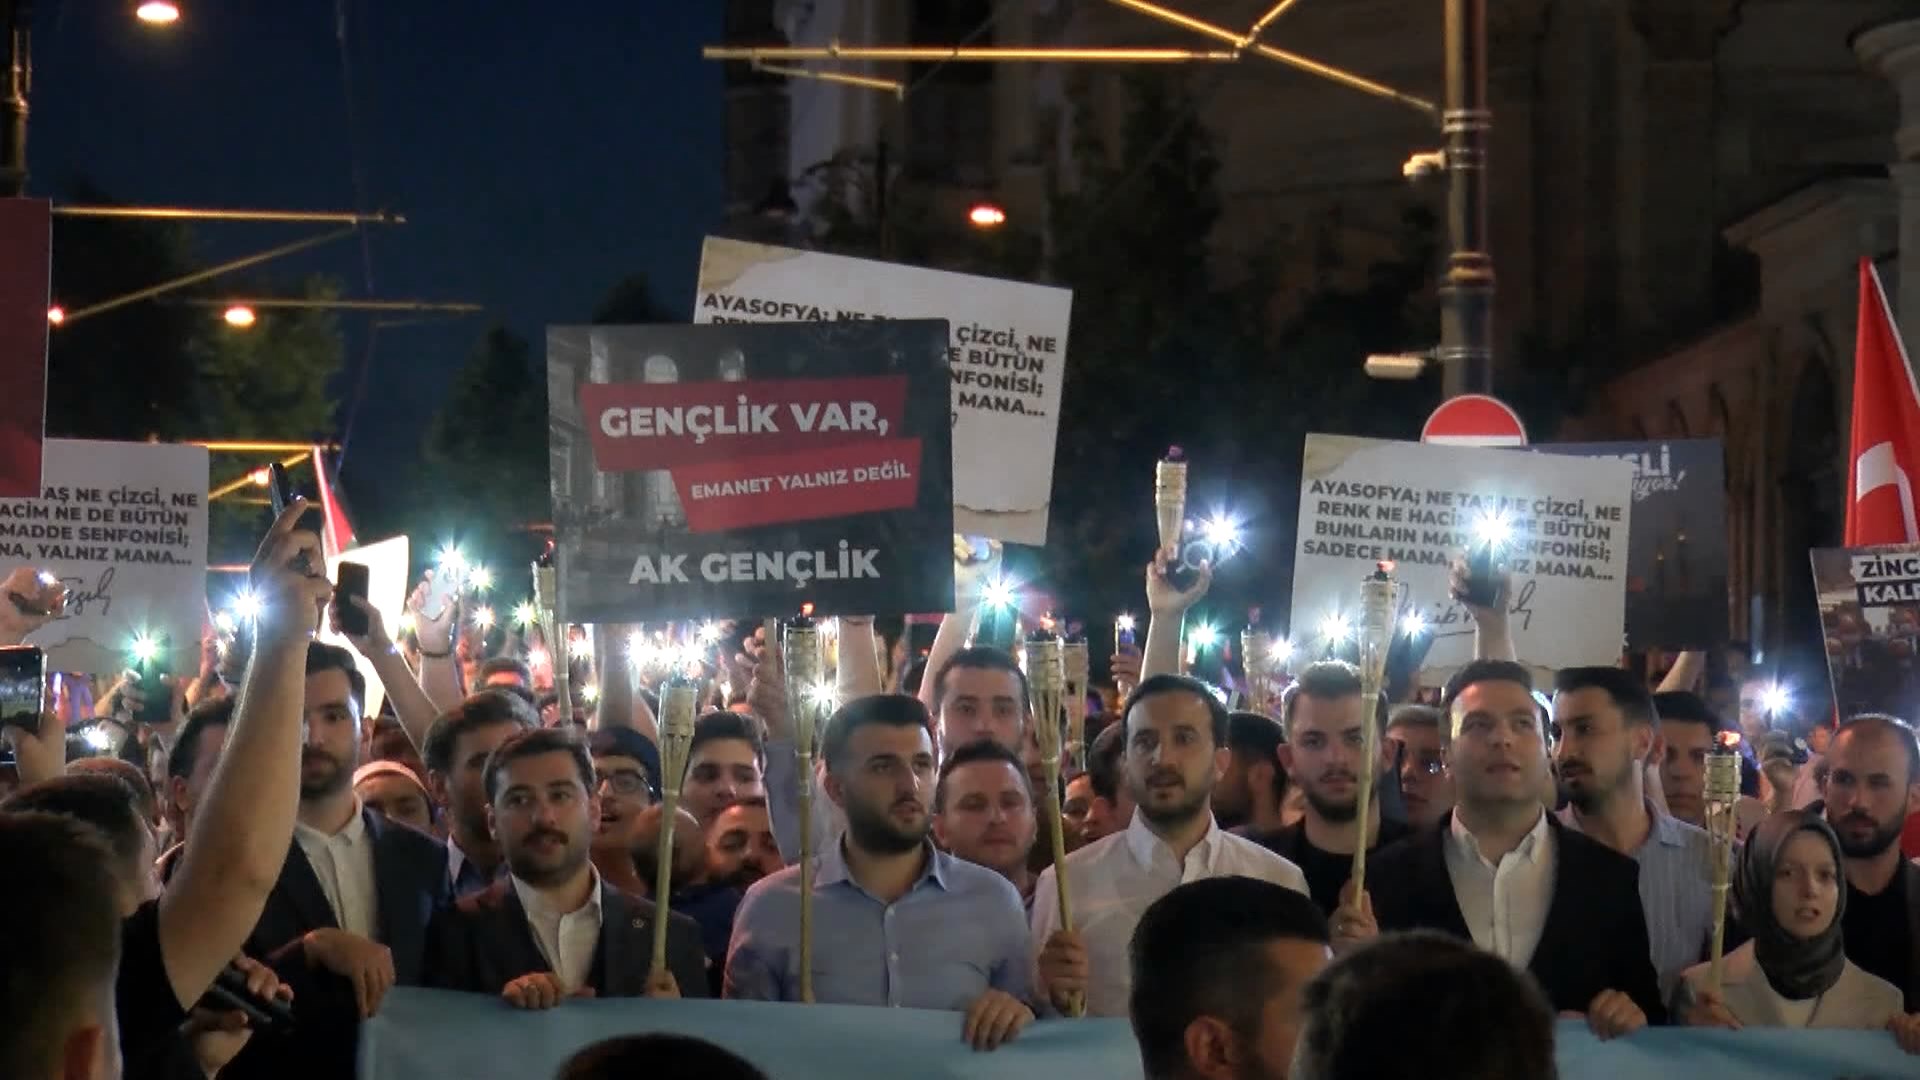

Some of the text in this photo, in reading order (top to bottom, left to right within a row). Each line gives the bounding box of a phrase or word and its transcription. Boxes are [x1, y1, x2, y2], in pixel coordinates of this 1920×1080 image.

[957, 323, 1020, 352] ÇİZGİ,
[1027, 335, 1057, 353] NE
[968, 347, 1044, 373] BÜTÜN
[950, 371, 1043, 398] NFONİSİ;
[958, 391, 1045, 416] MANA...
[600, 395, 889, 444] GENÇLİK VAR,
[691, 459, 911, 500] EMANET YALNIZ DEĞİL
[43, 485, 198, 508] AŞ NE ÇİZGİ, NE
[1310, 480, 1420, 506] AYASOFYA;
[1426, 491, 1453, 506] NE
[1457, 493, 1492, 508] TA
[1532, 496, 1589, 520] ÇİZGİ,
[1595, 504, 1621, 522] NE
[0, 501, 188, 526] ACİM NE DE BÜTÜN
[1317, 501, 1371, 520] RENK
[1376, 505, 1403, 522] NE
[1408, 507, 1467, 527] HACİ
[1543, 519, 1611, 540] BÜTÜN
[0, 523, 190, 548] MADDE SENFONİSİ;
[1314, 520, 1470, 548] BUNLARIN MAD
[0, 543, 192, 565] NA, YALNIZ MANA...
[1303, 539, 1382, 561] SADECE
[628, 540, 881, 588] AK GENÇLİK
[1535, 560, 1614, 581] MANA...
